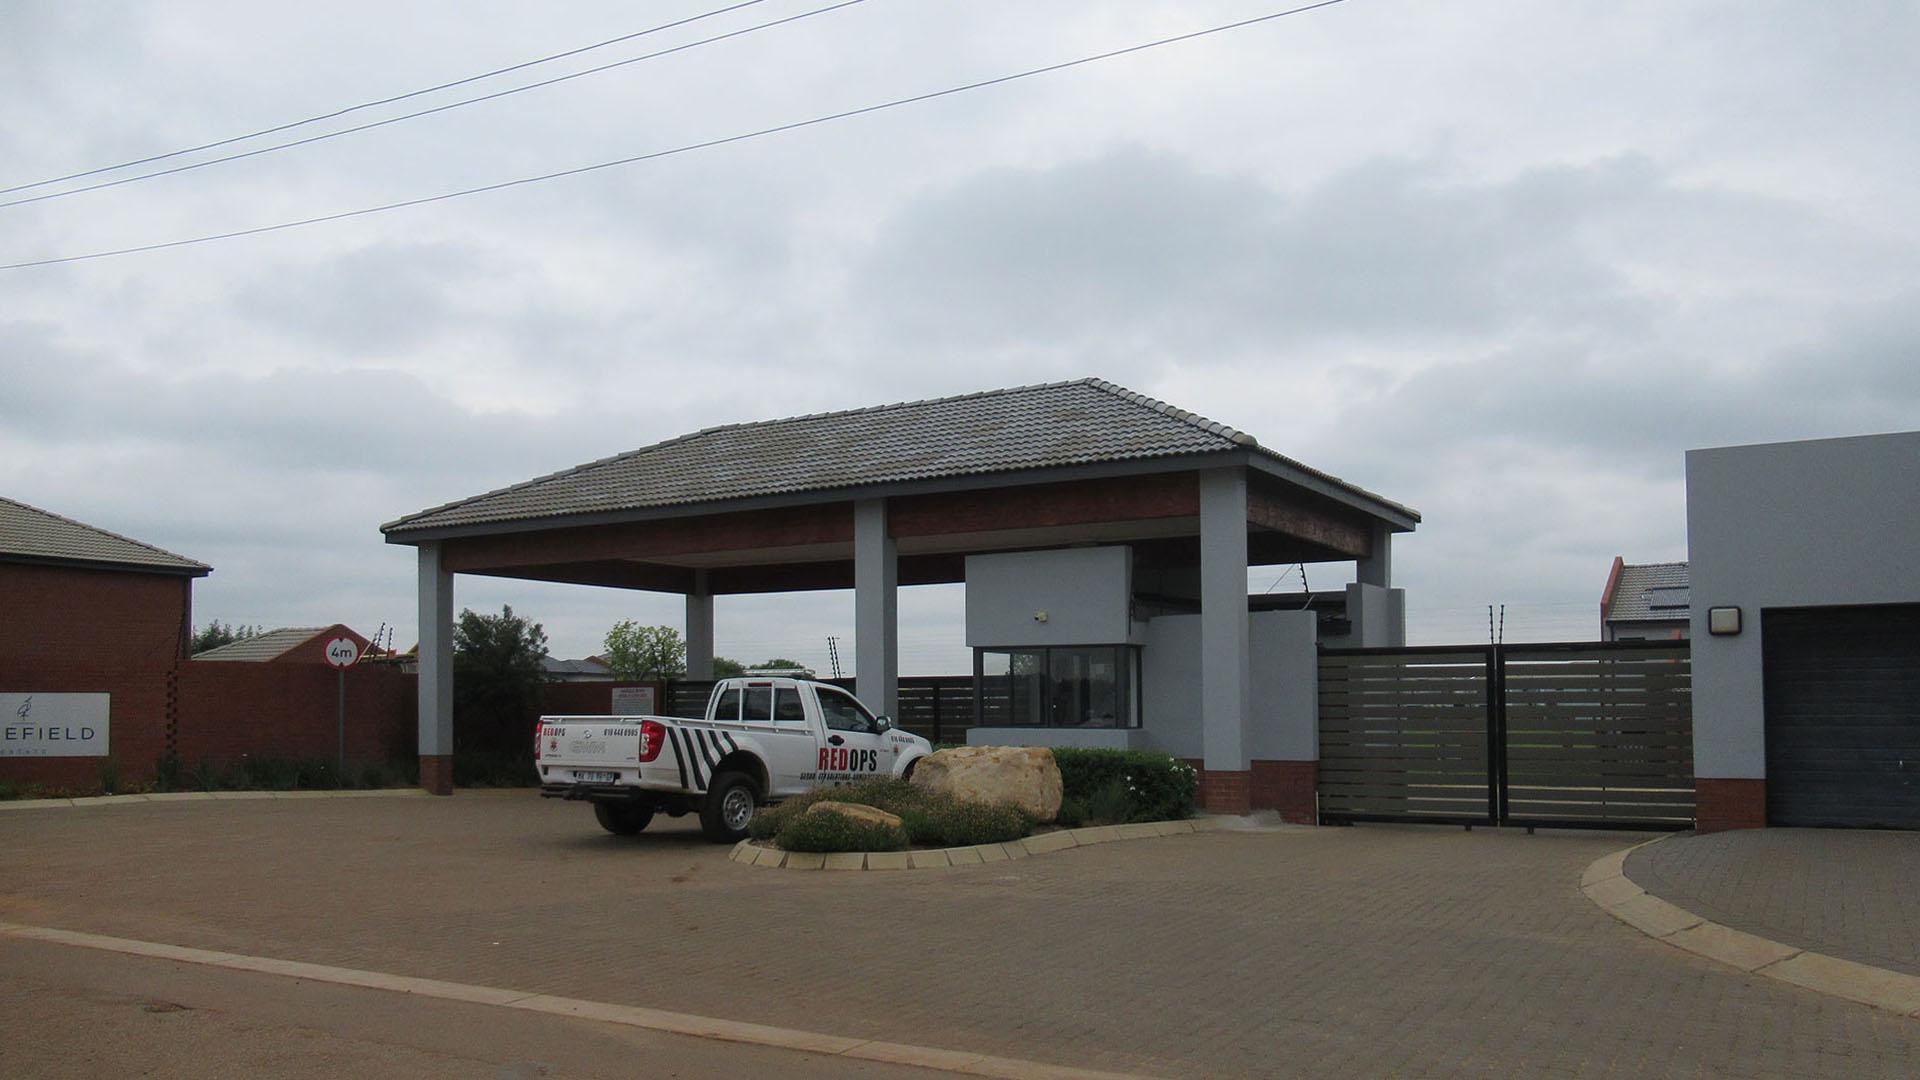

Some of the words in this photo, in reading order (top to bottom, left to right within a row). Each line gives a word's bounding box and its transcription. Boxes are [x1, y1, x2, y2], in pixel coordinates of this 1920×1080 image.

[331, 647, 352, 658] 4m
[5, 727, 95, 740] EFIELD
[543, 728, 566, 736] REDOPS
[818, 747, 877, 772] REDOPS
